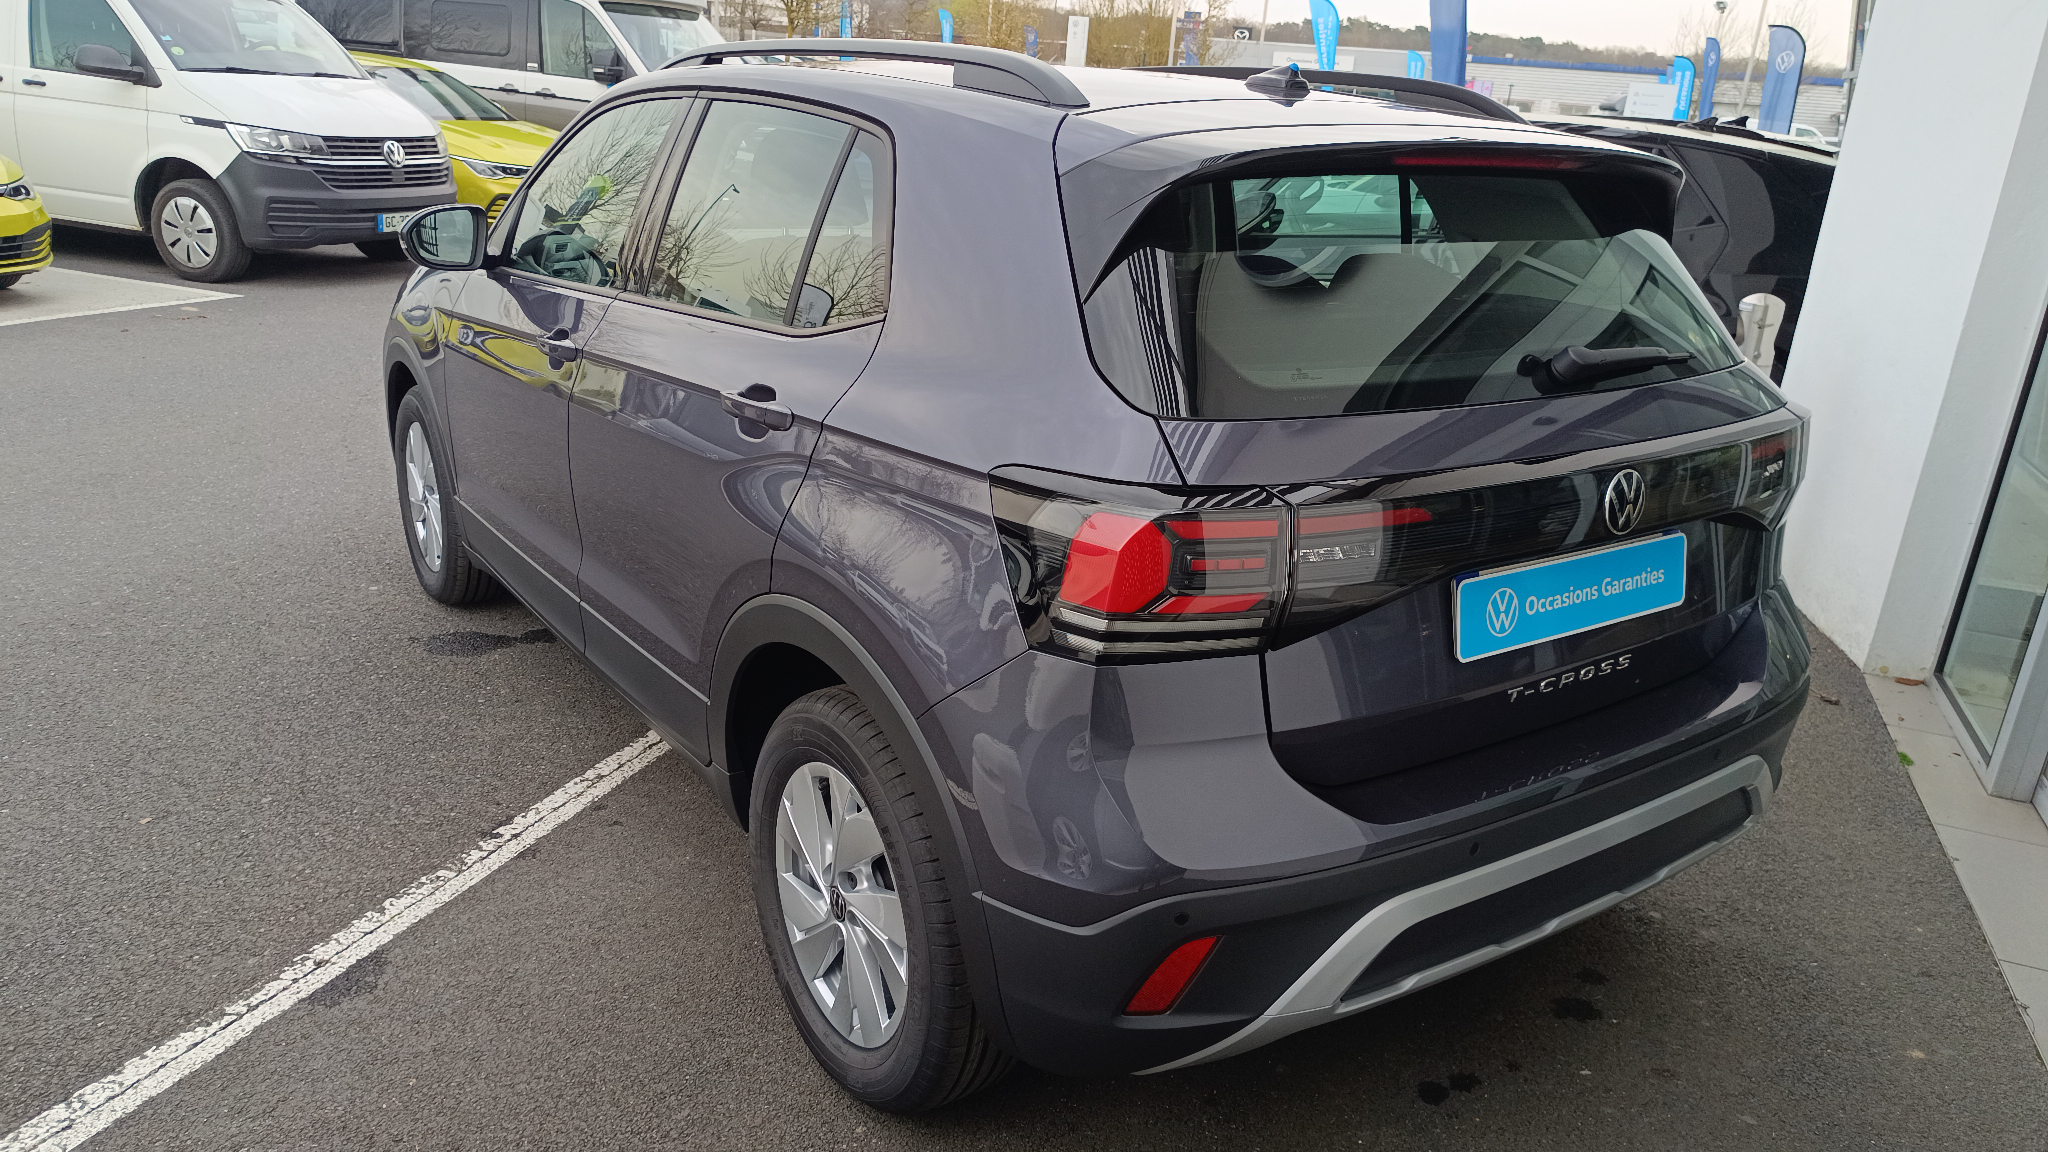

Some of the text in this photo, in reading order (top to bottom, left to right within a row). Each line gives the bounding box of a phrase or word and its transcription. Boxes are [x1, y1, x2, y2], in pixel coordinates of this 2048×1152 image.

[1525, 586, 1598, 616] Occasions
[1601, 567, 1665, 597] Garanties
[1507, 653, 1632, 703] T-CROSS
